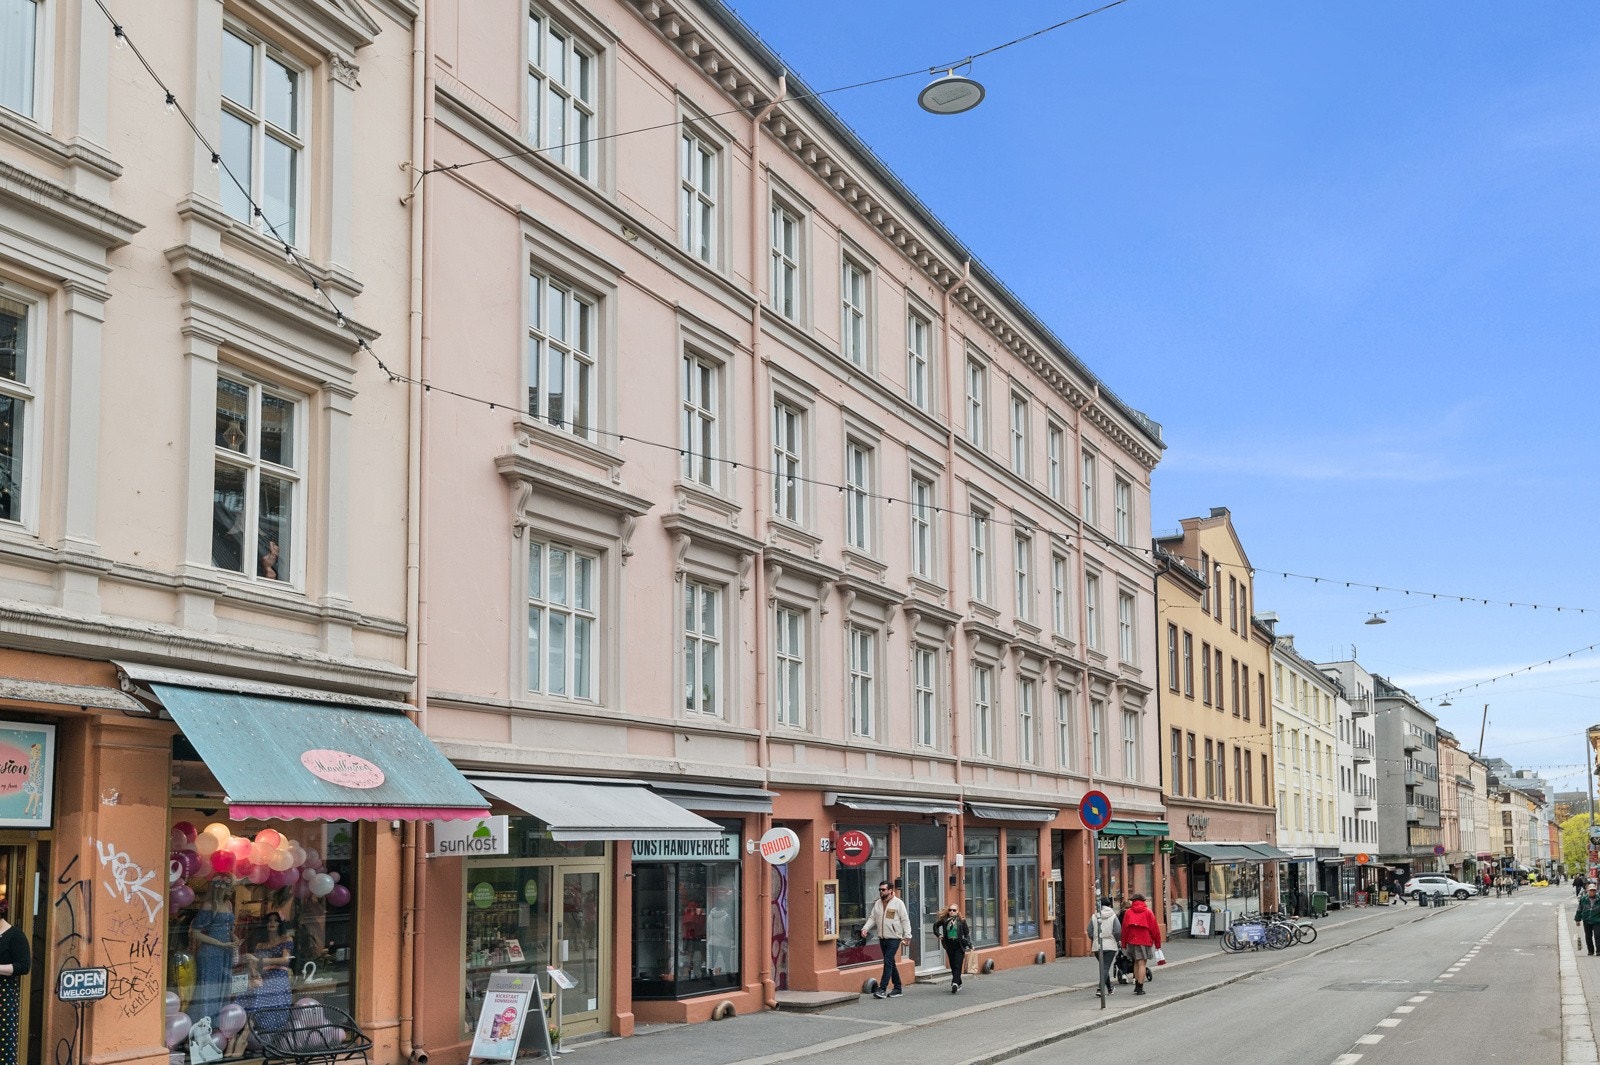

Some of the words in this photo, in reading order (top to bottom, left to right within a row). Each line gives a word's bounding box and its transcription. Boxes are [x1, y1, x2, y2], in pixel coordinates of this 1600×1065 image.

[440, 835, 497, 852] sunkost
[63, 972, 104, 988] OPEN
[63, 987, 103, 997] WELCOME
